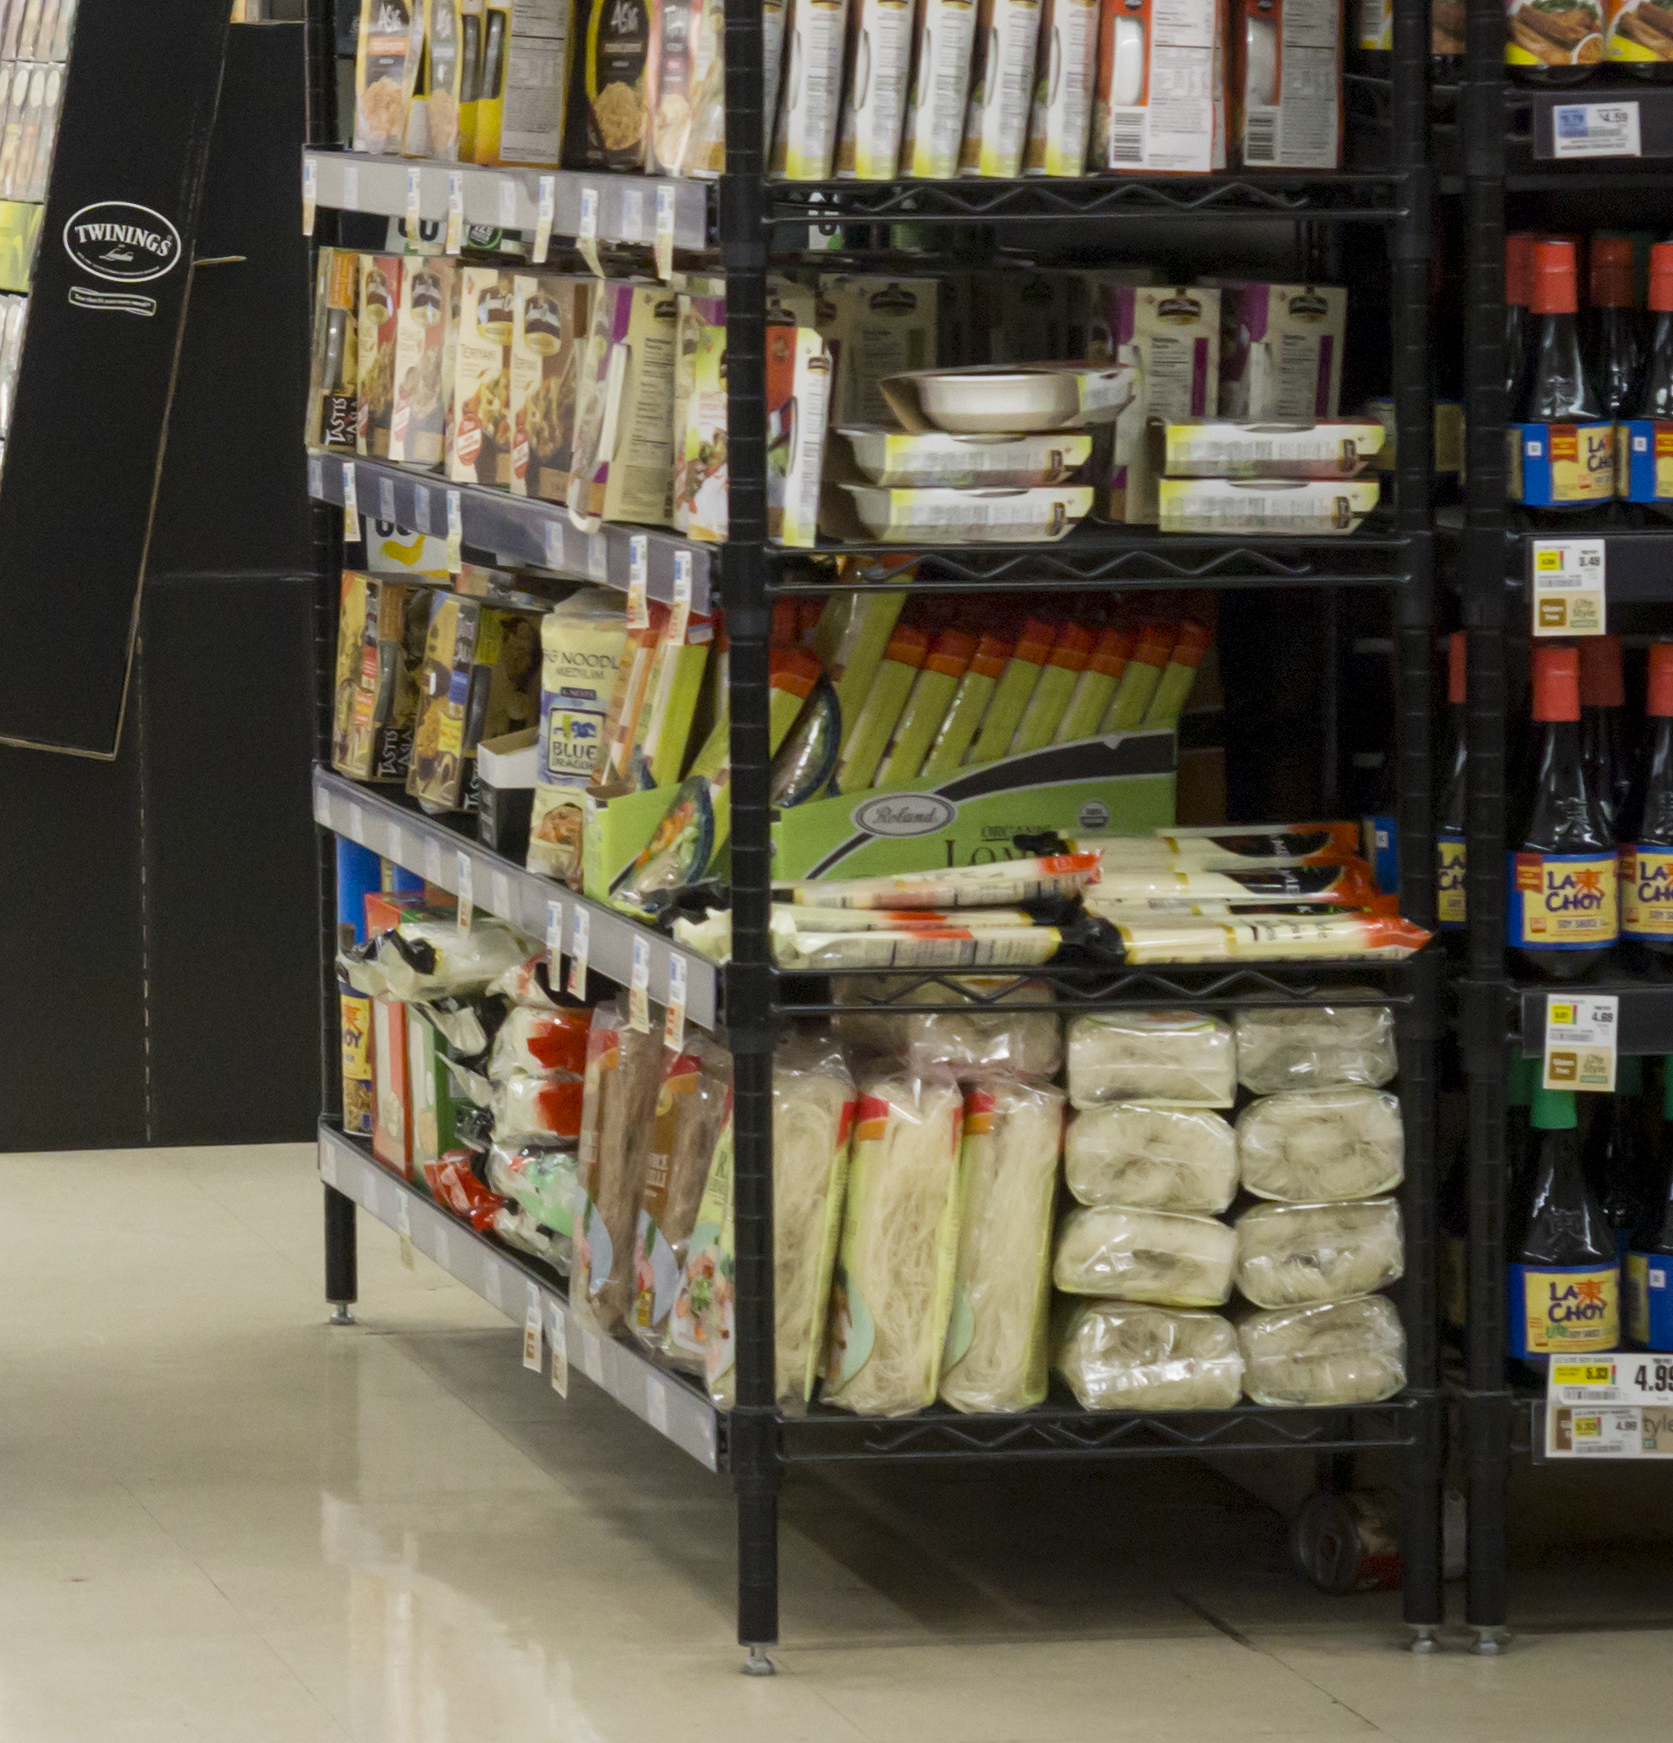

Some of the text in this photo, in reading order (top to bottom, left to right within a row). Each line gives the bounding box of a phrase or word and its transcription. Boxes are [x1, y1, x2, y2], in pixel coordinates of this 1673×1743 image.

[75, 223, 172, 257] TWININGS
[561, 650, 619, 670] NOODL
[553, 741, 598, 760] BLUE
[872, 806, 937, 825] Roland
[1547, 870, 1576, 890] LA
[1546, 891, 1605, 913] CHOY
[1638, 881, 1673, 903] CHO
[1549, 1281, 1578, 1302] LA
[1548, 1302, 1608, 1324] CHOY
